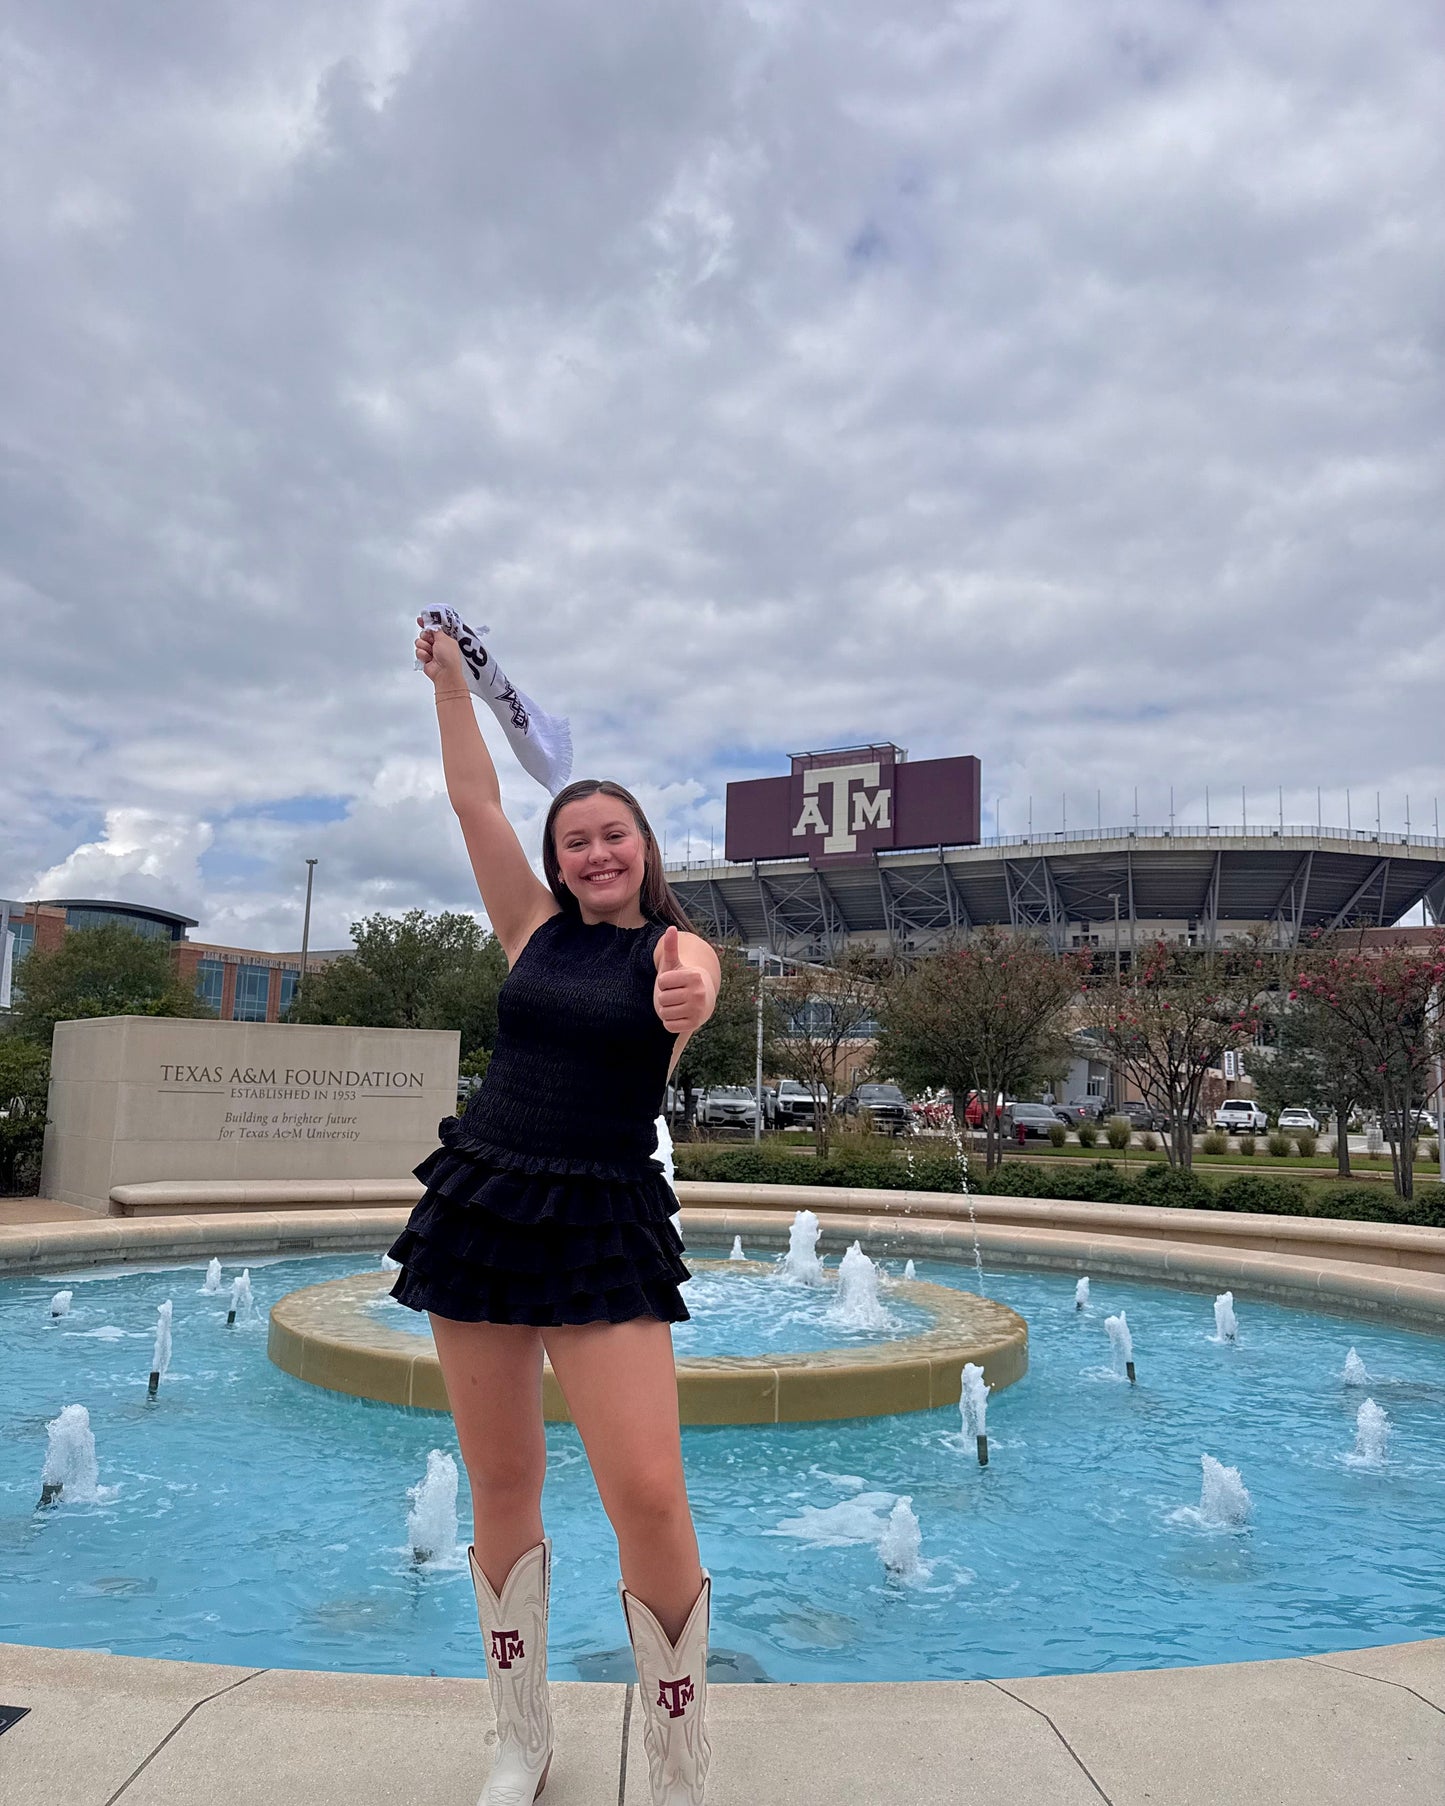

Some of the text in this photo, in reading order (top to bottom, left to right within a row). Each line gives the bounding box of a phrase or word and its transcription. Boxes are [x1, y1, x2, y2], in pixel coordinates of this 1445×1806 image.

[160, 1064, 424, 1088] TEXAS A&M FOUNDATION
[231, 1088, 356, 1101] ESTABLISHED IN 1953
[224, 1112, 357, 1127] Building a brighter future
[216, 1126, 361, 1142] for Texas A&M University
